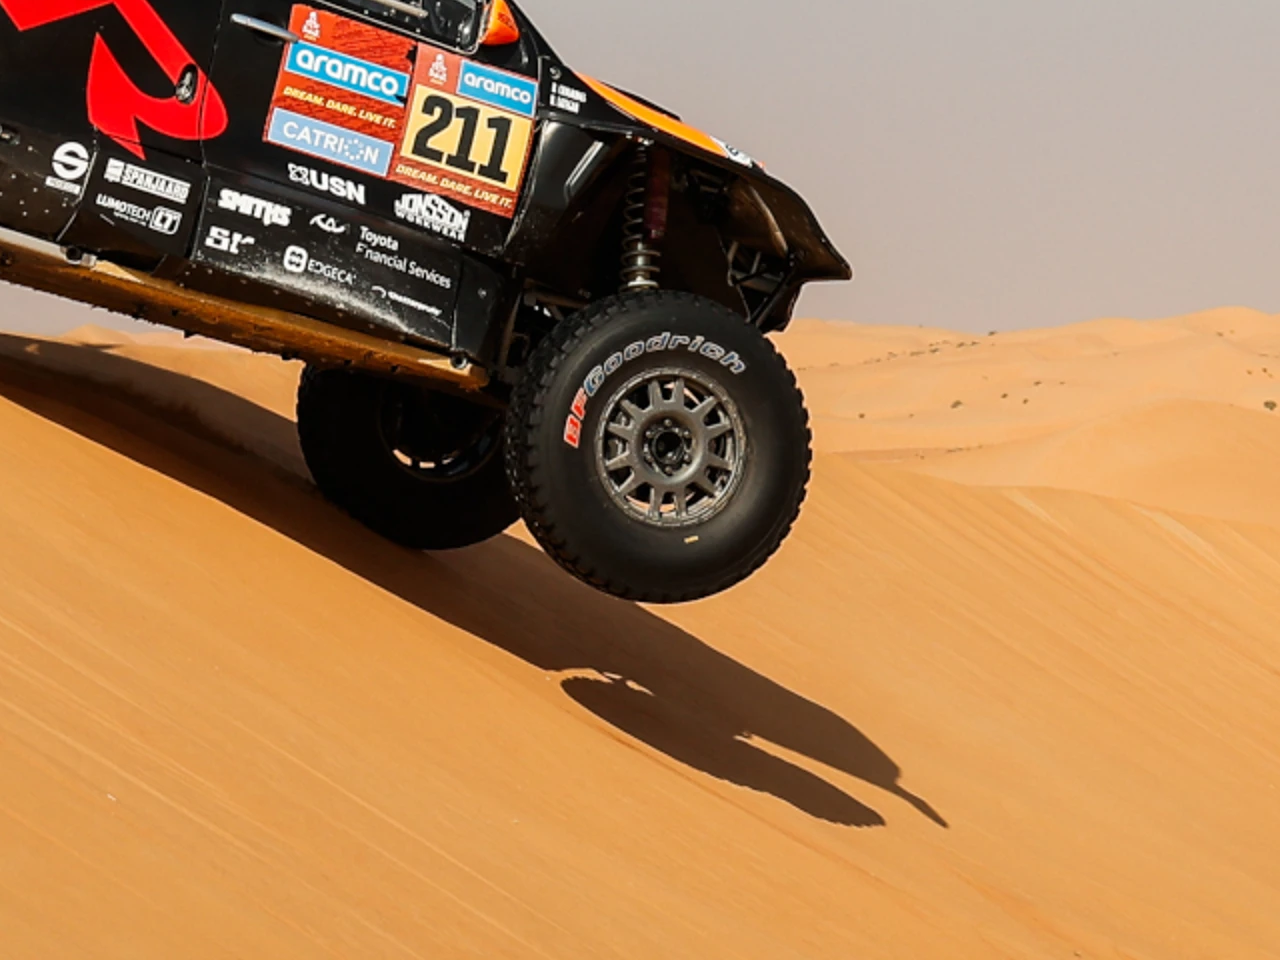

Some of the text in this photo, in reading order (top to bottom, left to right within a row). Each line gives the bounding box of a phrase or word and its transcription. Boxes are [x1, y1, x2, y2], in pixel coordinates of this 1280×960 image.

[296, 49, 399, 96] aramco
[463, 72, 532, 104] aramco
[283, 121, 380, 165] CATRION
[412, 95, 512, 184] 211
[309, 169, 366, 205] USN
[96, 193, 152, 221] LUMOTECH
[393, 193, 470, 233] JONSSON
[358, 225, 400, 251] Toyota
[407, 261, 452, 289] Services
[564, 332, 747, 448] BFGoodrich
